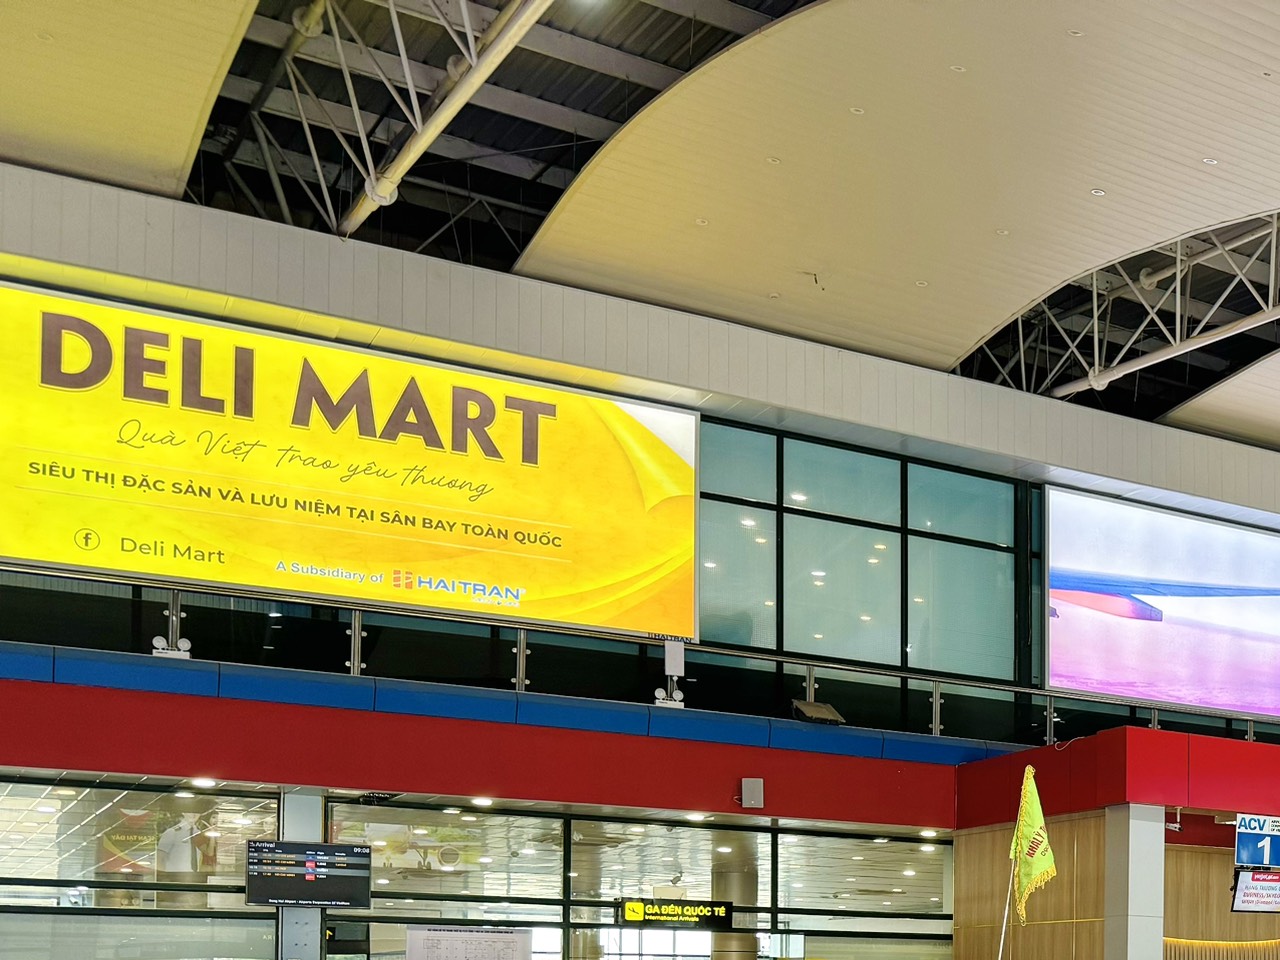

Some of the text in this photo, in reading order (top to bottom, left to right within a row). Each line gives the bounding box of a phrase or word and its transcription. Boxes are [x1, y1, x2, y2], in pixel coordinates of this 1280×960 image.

[39, 310, 557, 467] DELI MART
[116, 419, 186, 448] Quà
[197, 430, 267, 462] Việt
[276, 445, 339, 468] trao
[340, 461, 397, 483] yêu
[28, 461, 562, 548] SIÊU THỊ ĐẶC SẢN VÀ LƯU NIỆM TẠI SÂN BAY TOÀN QUỐC
[120, 537, 226, 564] Deli Mart
[276, 560, 384, 584] A Subsidiary of
[417, 575, 520, 600] HAITRAN
[1238, 817, 1266, 831] ACV
[1258, 836, 1271, 864] 1
[645, 904, 660, 914] GA
